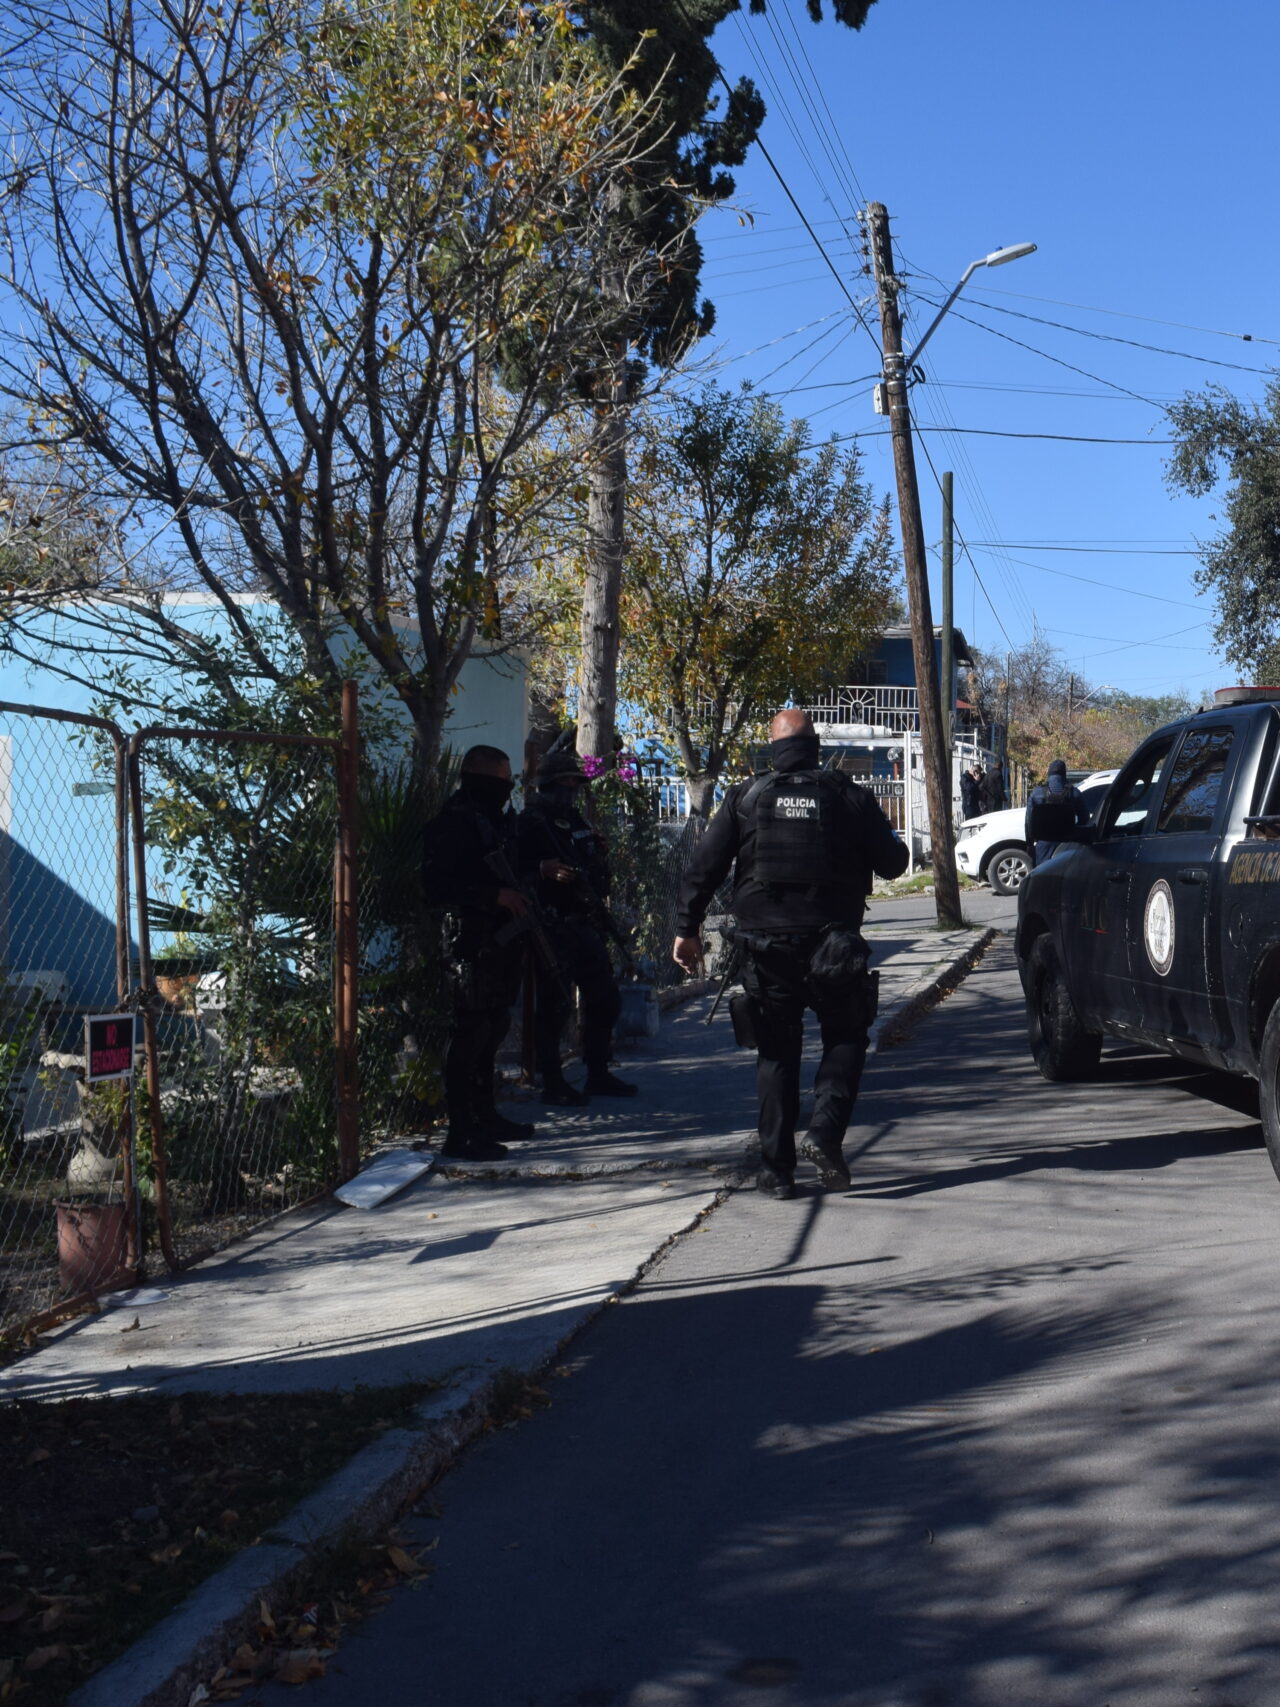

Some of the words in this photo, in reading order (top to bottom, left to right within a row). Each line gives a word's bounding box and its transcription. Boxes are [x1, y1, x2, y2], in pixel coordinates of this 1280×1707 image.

[776, 797, 816, 808] POLICIA
[785, 808, 810, 818] CIVIL
[1229, 852, 1266, 885] AGENCIA
[1260, 851, 1278, 884] DE
